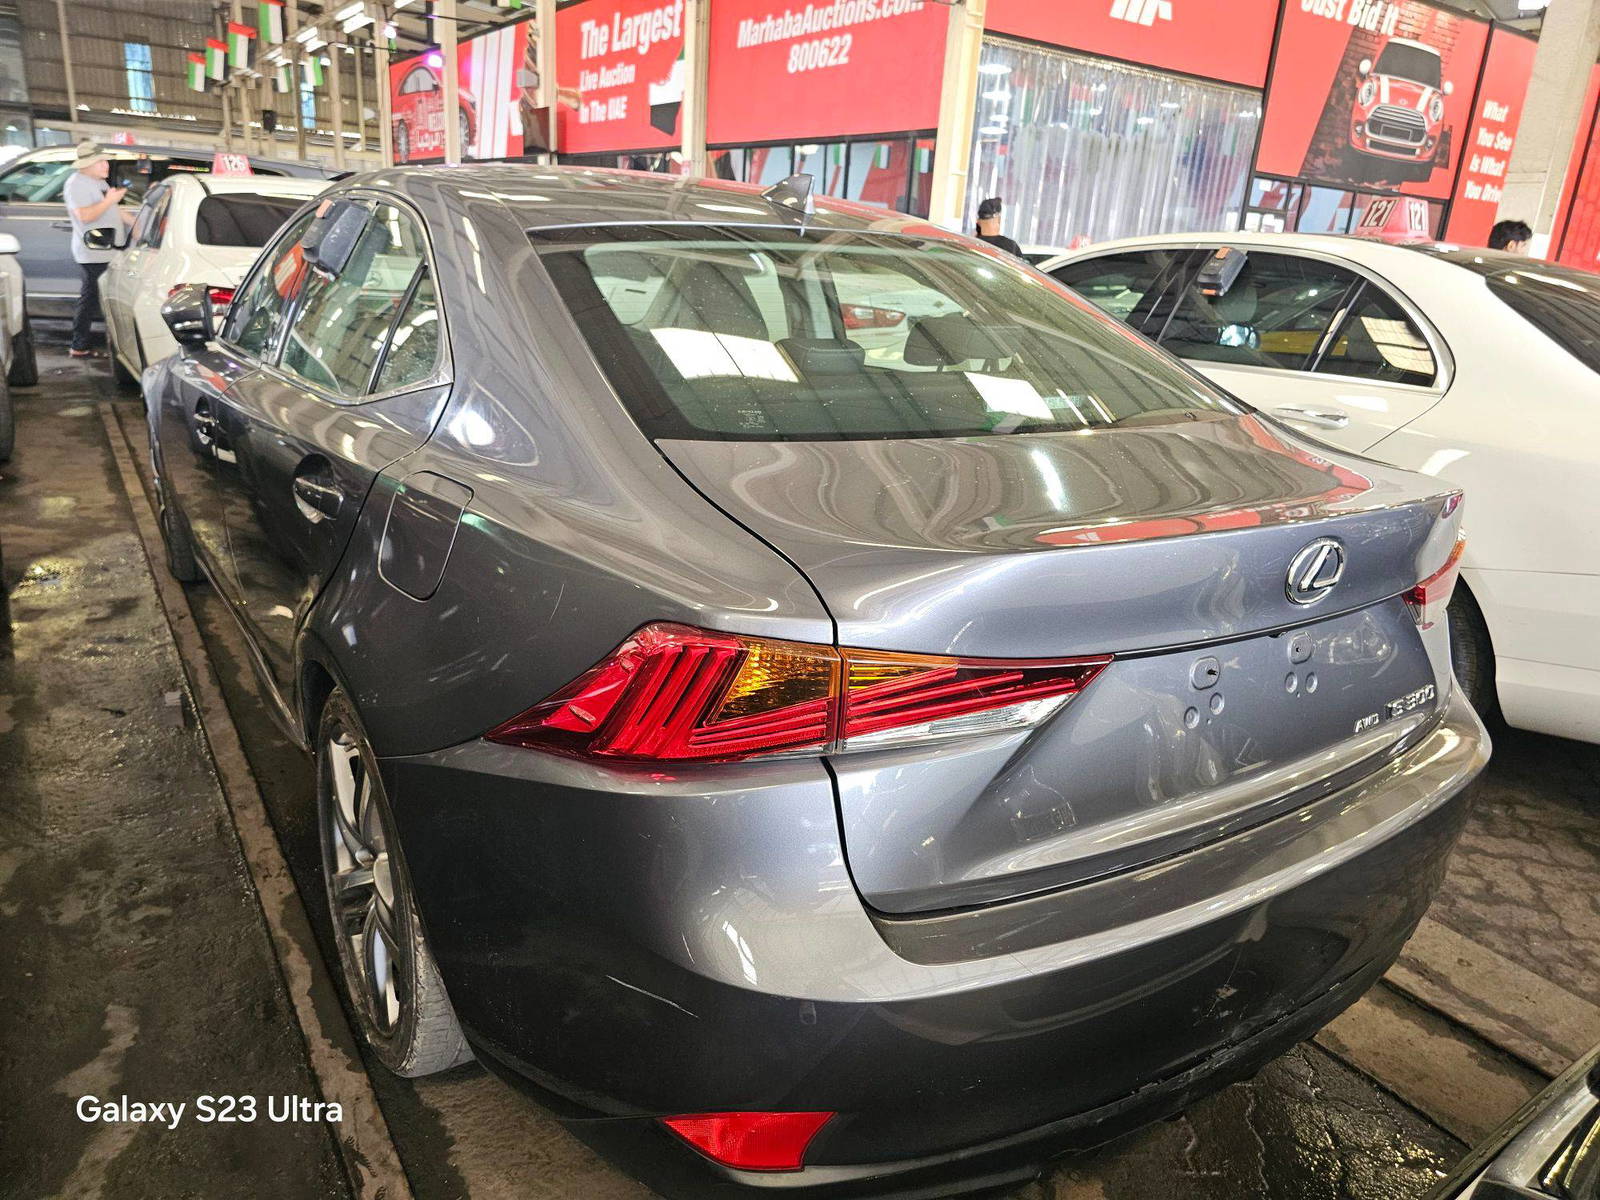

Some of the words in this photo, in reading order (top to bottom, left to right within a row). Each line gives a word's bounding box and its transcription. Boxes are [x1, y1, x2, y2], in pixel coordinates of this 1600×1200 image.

[581, 19, 609, 59] The
[611, 0, 683, 55] Largest
[1347, 0, 1383, 31] Bid
[1381, 3, 1399, 36] It
[787, 34, 852, 73] 800622
[579, 69, 598, 92] Live
[599, 62, 636, 88] Auction
[590, 100, 607, 122] The
[607, 96, 628, 120] UAE
[1482, 99, 1509, 122] What
[1477, 127, 1495, 148] You
[1494, 131, 1513, 151] See
[1480, 156, 1506, 177] What
[1464, 180, 1483, 199] You
[1481, 183, 1503, 203] Driv
[1362, 200, 1398, 227] 121
[1409, 201, 1426, 231] 121
[1353, 713, 1379, 733] AWD
